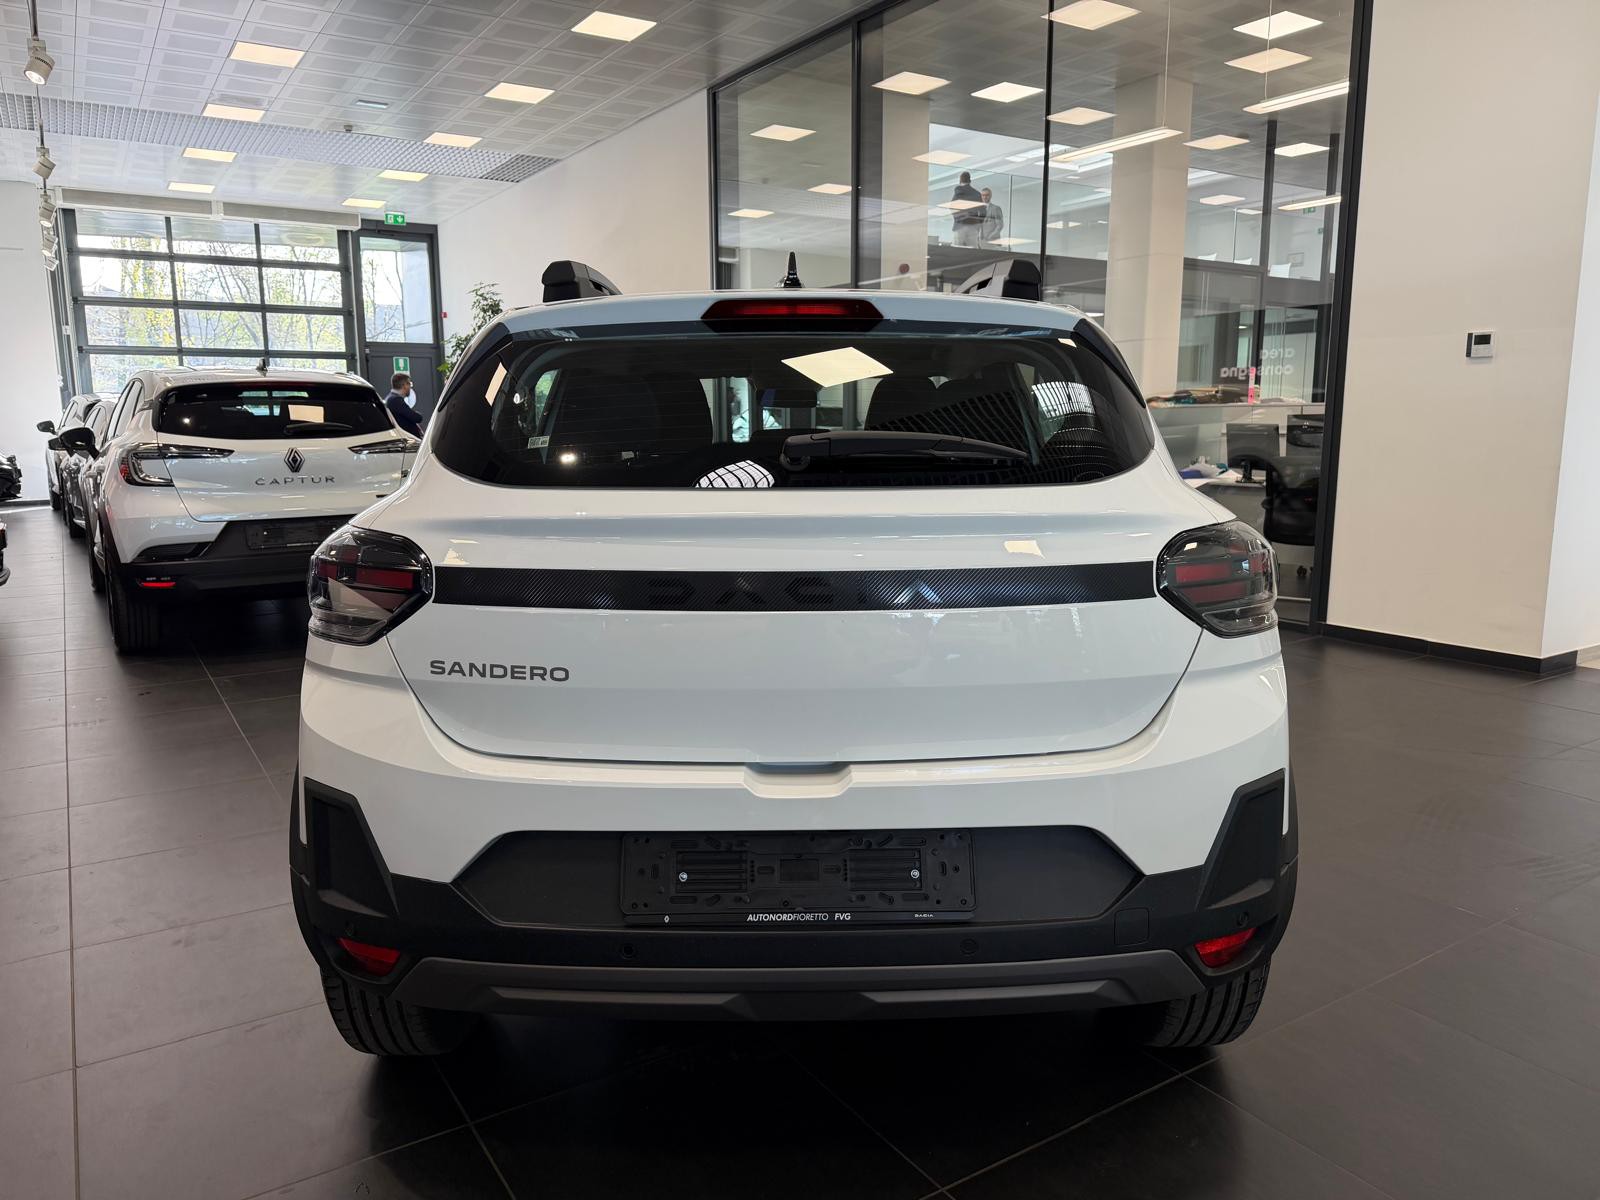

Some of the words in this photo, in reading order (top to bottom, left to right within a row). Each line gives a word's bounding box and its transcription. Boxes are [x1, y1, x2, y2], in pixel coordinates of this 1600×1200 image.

[255, 475, 335, 486] CAPTUR
[429, 659, 570, 683] SANDERO
[747, 913, 829, 921] AUTONORDFIORETTO
[835, 912, 851, 921] FVG
